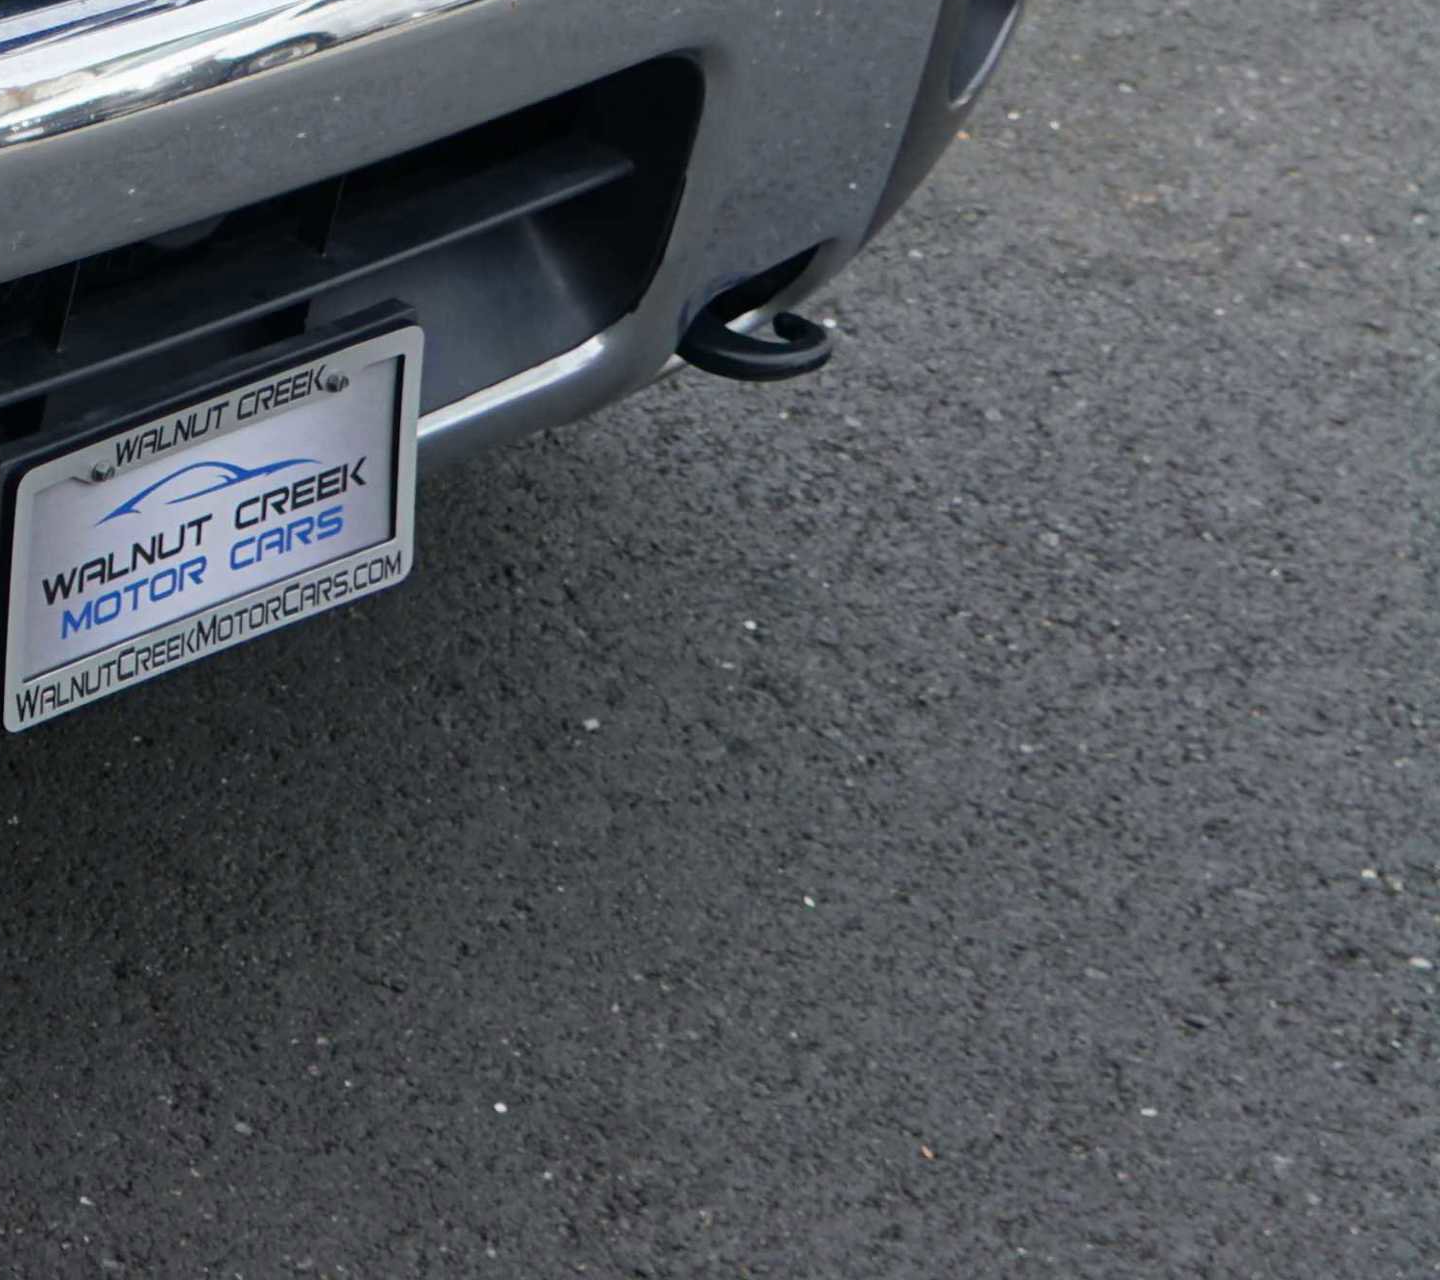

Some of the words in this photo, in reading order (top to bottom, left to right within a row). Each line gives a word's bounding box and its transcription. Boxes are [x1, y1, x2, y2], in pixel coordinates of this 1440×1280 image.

[114, 402, 230, 466] WALNUT
[236, 364, 328, 423] CREEK
[41, 514, 213, 605] WALNUT
[234, 456, 367, 530] CREEK
[60, 554, 209, 640] MOTOR
[229, 504, 345, 571] CARS
